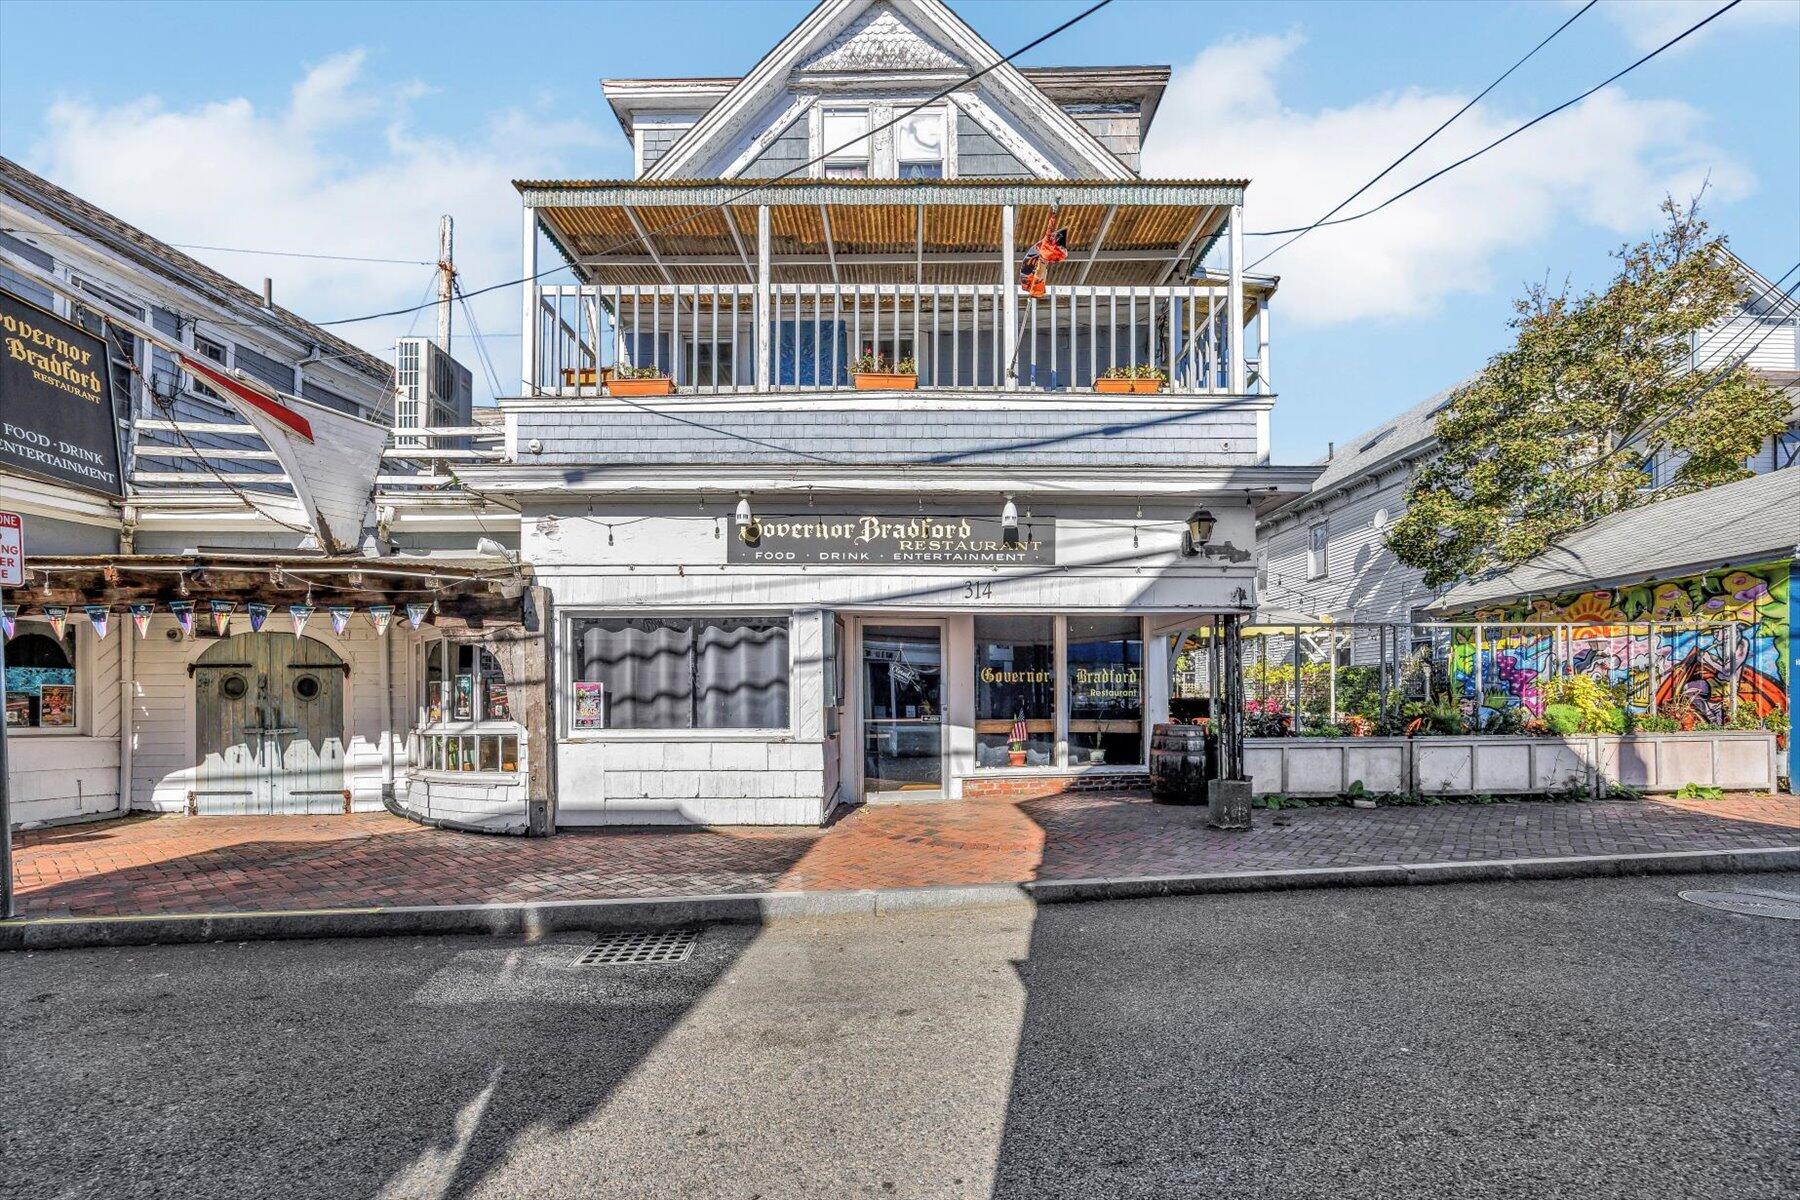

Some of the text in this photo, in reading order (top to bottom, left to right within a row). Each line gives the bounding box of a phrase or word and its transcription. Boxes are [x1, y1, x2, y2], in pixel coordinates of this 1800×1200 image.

[0, 313, 92, 365] overnor
[5, 337, 101, 393] Bradford
[32, 369, 101, 404] RESTAURANT
[3, 422, 104, 466] FOOD DRINK
[854, 516, 971, 546] Bradford
[755, 551, 1026, 562] FOOD DRINK ENTERTAINMENT
[900, 540, 1042, 552] RESTAURANT
[964, 581, 993, 600] 314
[981, 667, 1137, 684] Governor Bradford
[1090, 688, 1137, 697] Restaurant
